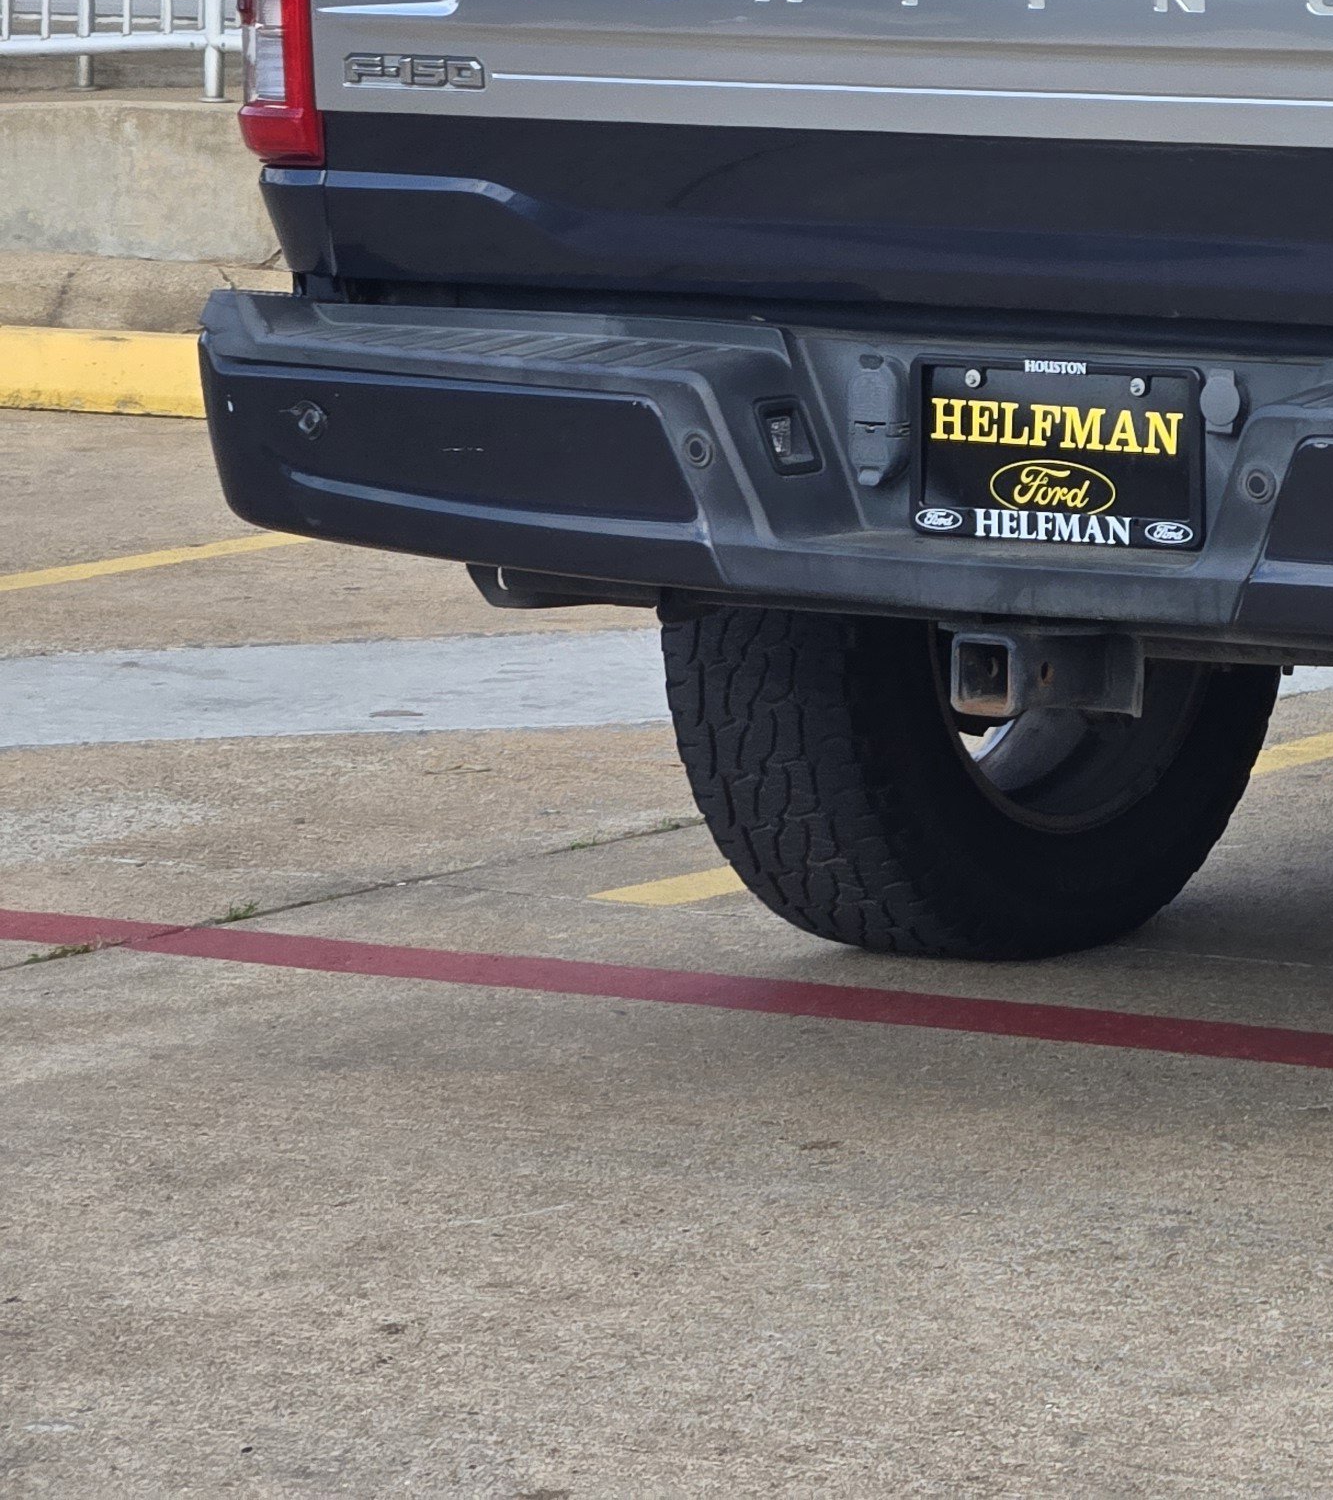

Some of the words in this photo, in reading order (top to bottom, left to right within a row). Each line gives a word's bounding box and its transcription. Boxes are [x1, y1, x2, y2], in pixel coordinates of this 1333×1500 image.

[344, 53, 486, 92] F-150
[1024, 359, 1087, 375] HOUSTON
[930, 397, 1184, 456] HELFMAN
[1013, 465, 1091, 509] Ford
[974, 508, 1133, 546] HELFMAN
